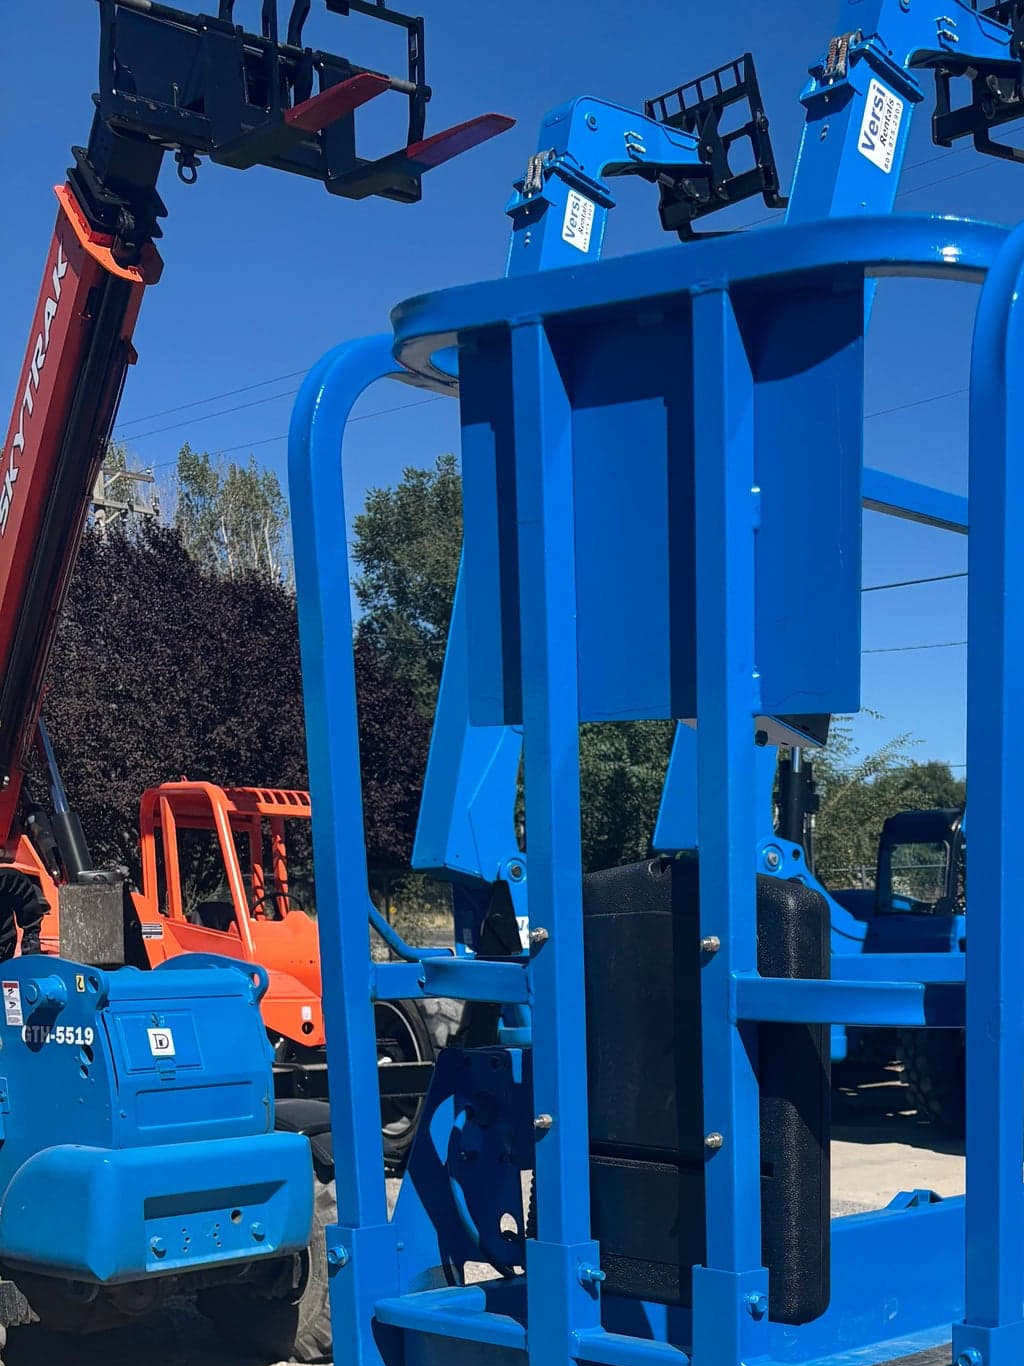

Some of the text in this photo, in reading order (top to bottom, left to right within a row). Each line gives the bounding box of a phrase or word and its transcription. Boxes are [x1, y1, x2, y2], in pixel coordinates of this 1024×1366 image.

[862, 84, 886, 151] Versi
[880, 97, 895, 147] Rentals
[565, 194, 581, 238] Versi
[0, 238, 68, 537] SKYTRAK
[22, 1024, 94, 1045] GTH-5519
